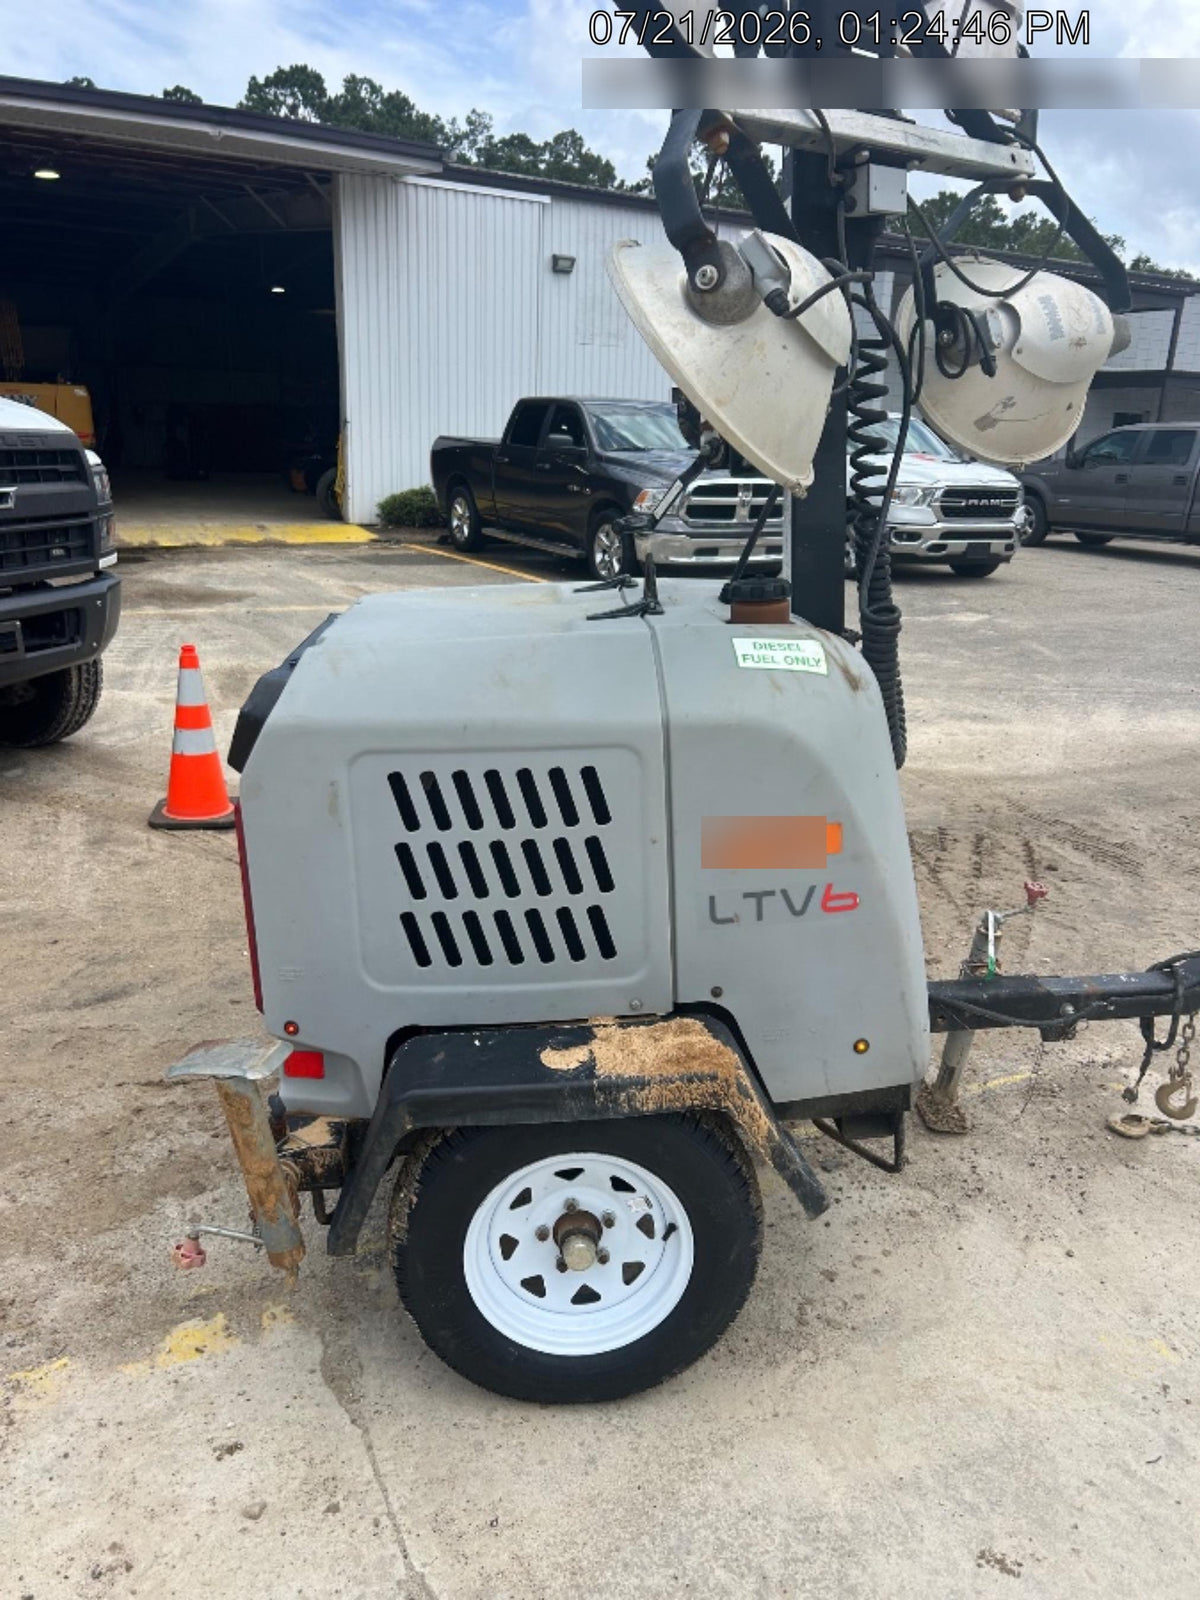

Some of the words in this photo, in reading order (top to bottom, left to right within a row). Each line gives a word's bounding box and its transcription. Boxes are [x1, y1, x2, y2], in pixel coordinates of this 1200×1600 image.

[967, 498, 1001, 506] RAM
[752, 641, 803, 652] DIESEL
[741, 653, 778, 664] FUEL
[783, 655, 821, 667] ONLY
[708, 882, 860, 925] LTV6
